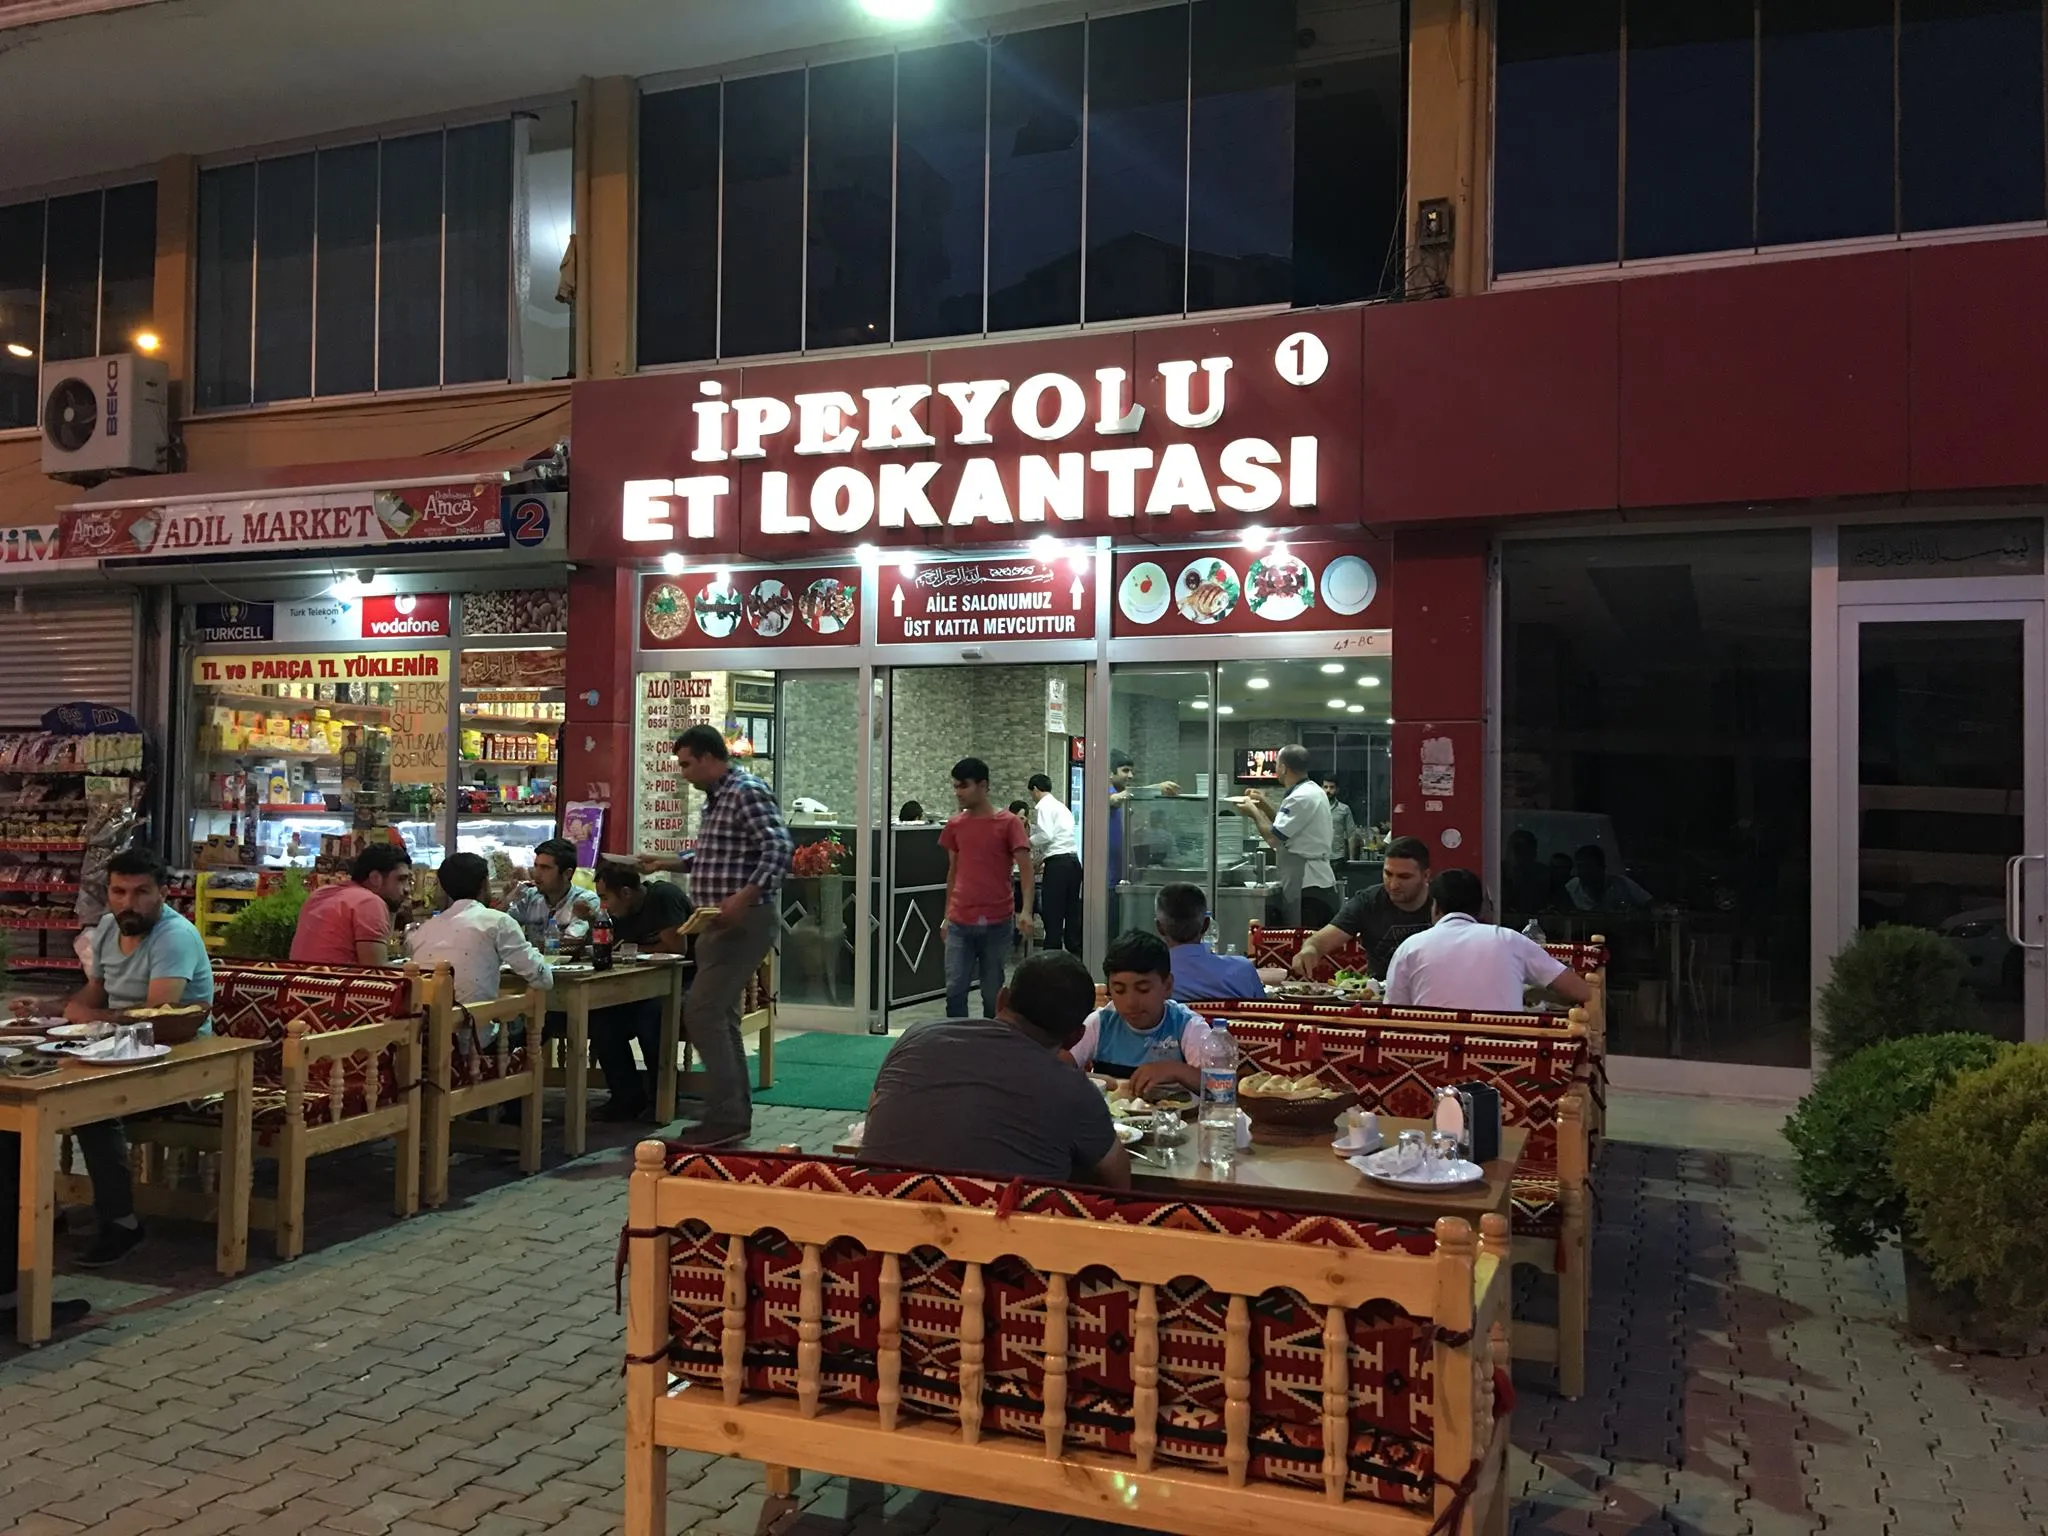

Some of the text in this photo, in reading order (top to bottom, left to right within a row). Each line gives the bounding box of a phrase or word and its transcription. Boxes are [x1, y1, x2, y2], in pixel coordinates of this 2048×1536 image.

[1289, 339, 1305, 376] 1
[106, 360, 119, 436] BEKO
[691, 356, 1233, 462] İPEKYOLU
[622, 435, 1318, 542] ET LOKANTASI
[423, 494, 472, 522] Amca
[241, 505, 374, 544] MARKET
[516, 501, 545, 540] 2
[308, 606, 339, 617] Telekom
[926, 591, 1053, 613] AİLE SALONUMUZ
[204, 626, 265, 641] TURKCELL
[371, 617, 440, 634] vodafone
[904, 615, 1076, 637] ÜST KATTA MEVCUTTUR
[201, 654, 439, 681] TL ve PARÇA TL YÜKLENİR
[647, 678, 712, 698] ALO PAKET
[648, 705, 668, 715] 0412
[687, 704, 697, 715] 51
[699, 704, 710, 715] 50
[391, 713, 413, 733] SU
[647, 718, 668, 728] 0534
[656, 740, 674, 757] ÇOR
[656, 759, 680, 773] LAHM
[656, 776, 676, 792] PİDE
[655, 800, 681, 812] BALIK
[655, 818, 683, 830] KEBAP
[654, 838, 698, 851] SULU YEM
